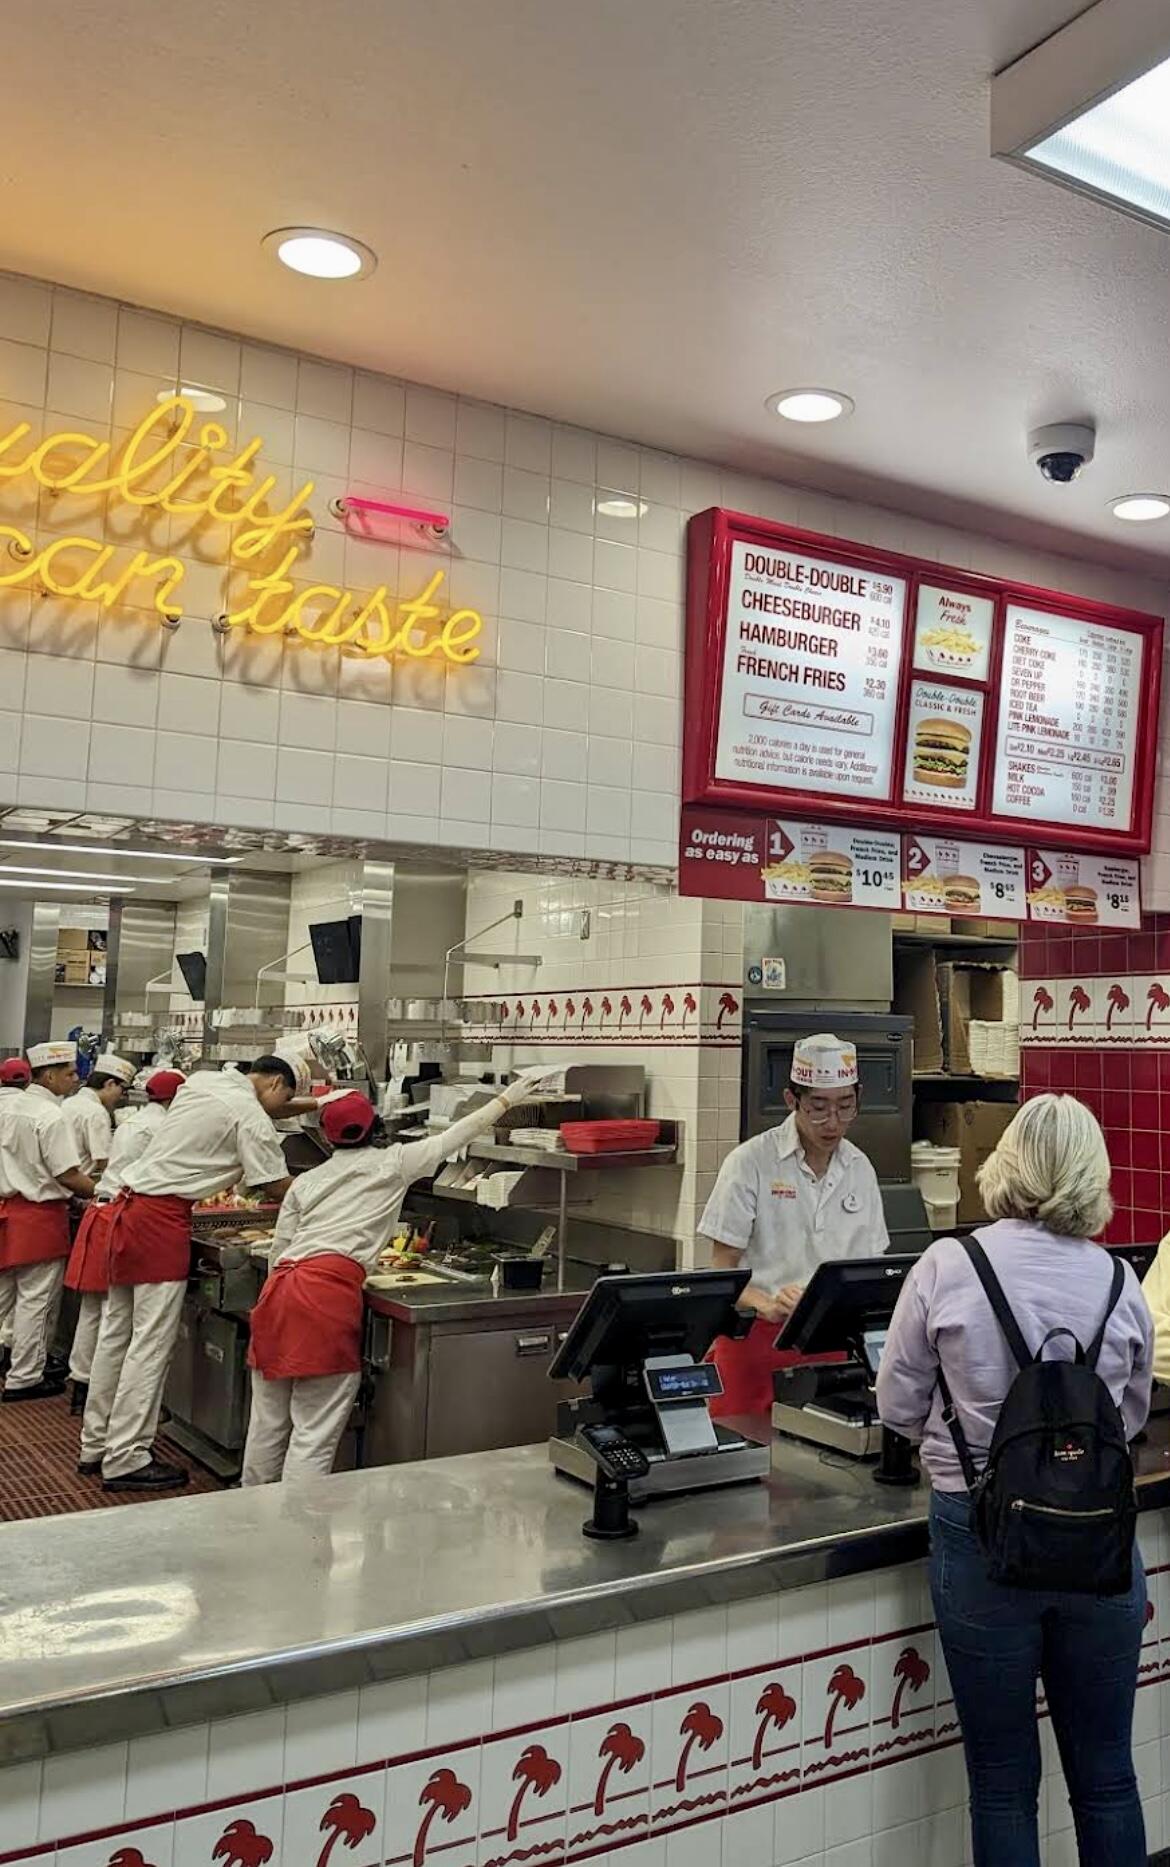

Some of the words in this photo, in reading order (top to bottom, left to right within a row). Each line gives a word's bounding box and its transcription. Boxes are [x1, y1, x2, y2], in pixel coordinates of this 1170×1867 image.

[744, 552, 866, 597] DOUBLE-DOUBLE
[226, 546, 483, 664] taste
[741, 589, 861, 632] CHEESEBURGER
[938, 595, 971, 613] Always
[940, 610, 967, 625] Fresh
[739, 620, 838, 657] HAMBURGER
[1013, 633, 1031, 645] COKE
[1013, 644, 1038, 658] CHERRY
[1039, 648, 1057, 662] COKE
[1012, 655, 1027, 666] DIET
[1028, 658, 1045, 670] COKE
[737, 655, 799, 683] FRENCH
[803, 666, 846, 692] FRIES
[866, 678, 886, 690] $2.30
[1012, 666, 1033, 678] SEVEN
[1034, 670, 1043, 681] UP
[1010, 677, 1020, 687] DR
[1022, 679, 1046, 692] PEPPER
[915, 687, 977, 706] Double-Double
[1010, 688, 1027, 699] ROOT
[1028, 691, 1045, 702] BEER
[759, 701, 780, 716] Gift
[782, 705, 811, 719] Cards
[814, 710, 860, 727] Available
[915, 699, 944, 712] CLASSIC
[946, 704, 952, 712] &
[954, 705, 976, 716] FRESH
[1009, 699, 1024, 710] ICED
[1025, 702, 1038, 712] TEA
[1008, 710, 1023, 720] PINK
[1024, 713, 1060, 728] LEMONADE
[1008, 723, 1020, 732] LITE
[1021, 725, 1037, 735] PINK
[1037, 727, 1070, 741] LEMONADE
[1008, 760, 1037, 774] SHAKES
[1007, 771, 1024, 783] MILK
[1006, 783, 1021, 794] HOT
[1021, 785, 1045, 797] COCOA
[1006, 794, 1032, 807] COFFEE
[691, 828, 755, 851] Ordering
[769, 831, 785, 855] 1
[684, 845, 703, 859] as
[705, 847, 742, 866] easy
[741, 852, 760, 864] as
[908, 847, 922, 870] 2
[1032, 860, 1045, 882] 3
